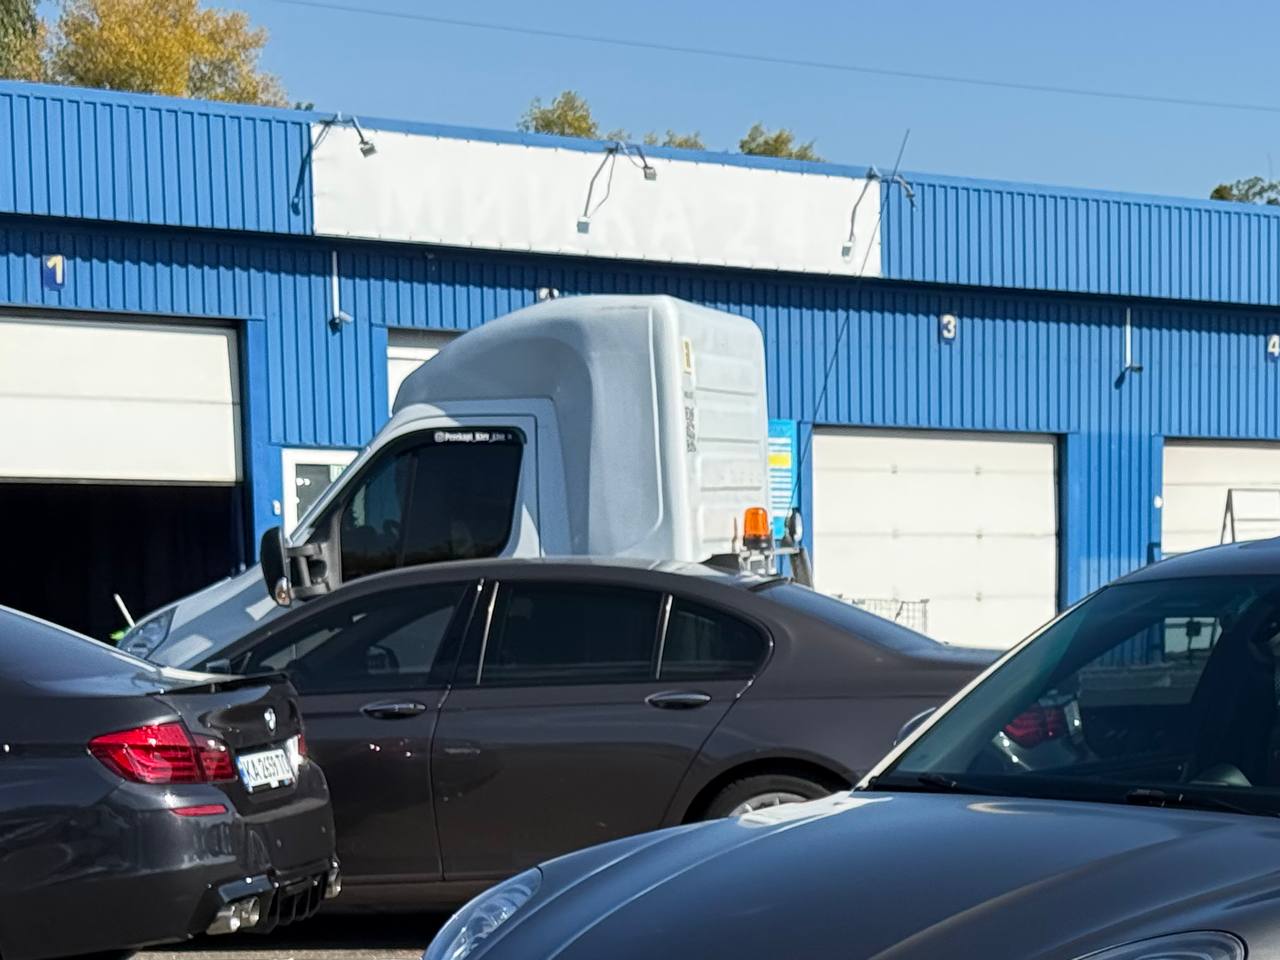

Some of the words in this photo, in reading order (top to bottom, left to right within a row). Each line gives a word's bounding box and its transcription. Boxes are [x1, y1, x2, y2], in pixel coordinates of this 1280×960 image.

[46, 254, 63, 284] 1
[942, 314, 956, 339] 3
[1267, 334, 1280, 357] 4
